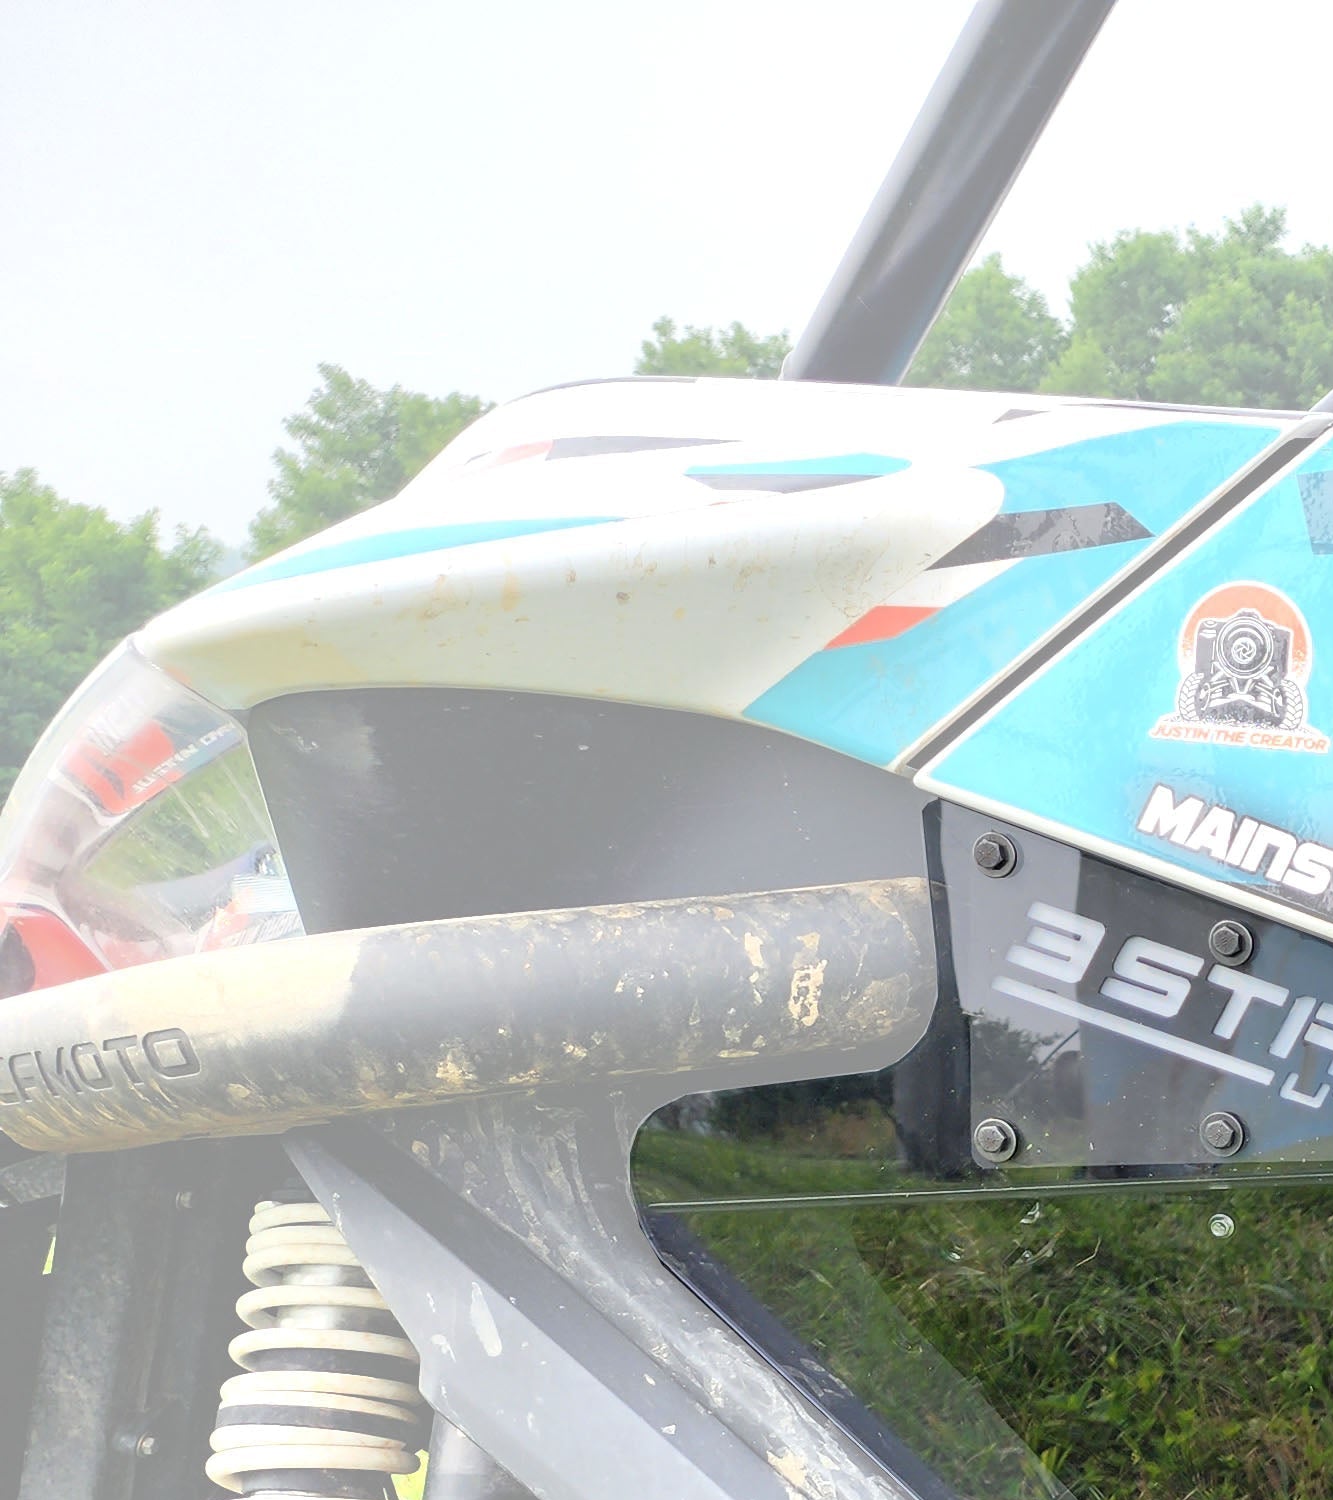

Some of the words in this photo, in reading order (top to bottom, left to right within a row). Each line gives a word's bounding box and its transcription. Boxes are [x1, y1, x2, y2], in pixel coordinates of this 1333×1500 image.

[1151, 725, 1211, 739] JUSTIN
[1215, 729, 1246, 743] THE
[1249, 732, 1328, 751] CREATOR
[1006, 901, 1106, 984] 3
